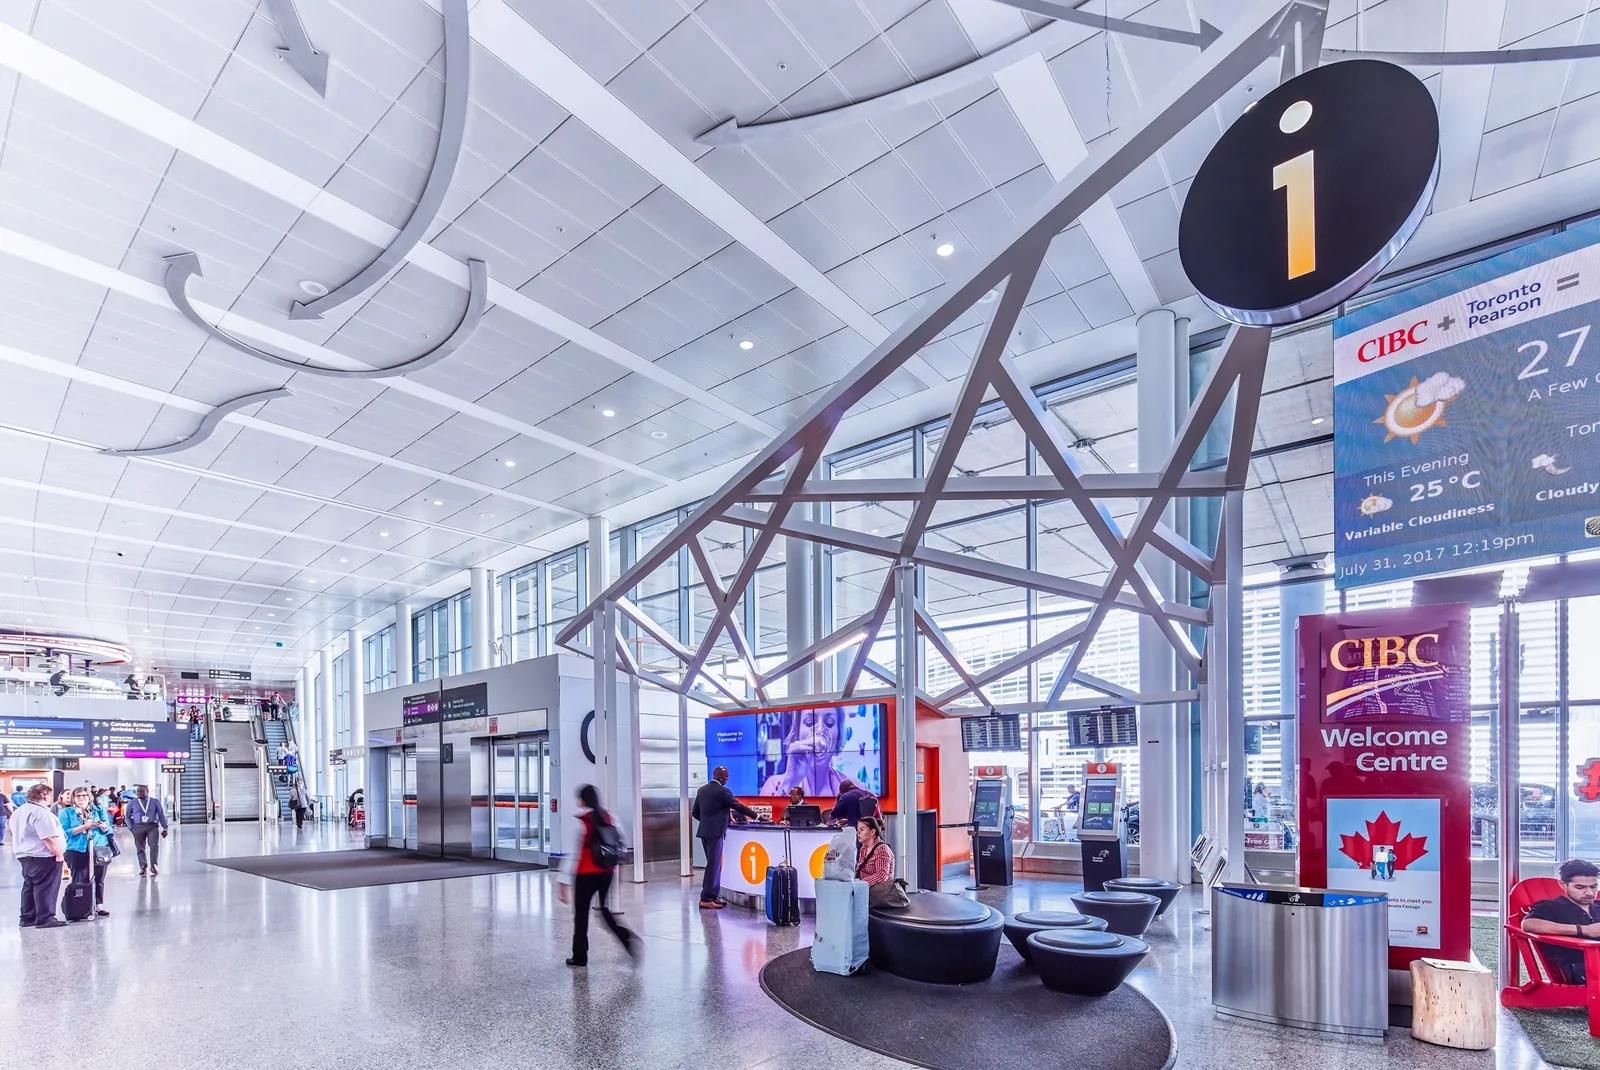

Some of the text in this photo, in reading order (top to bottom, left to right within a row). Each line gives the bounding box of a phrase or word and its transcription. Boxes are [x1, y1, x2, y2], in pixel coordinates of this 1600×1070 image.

[1466, 282, 1541, 314] Toronto
[1468, 297, 1541, 328] Pearson
[1357, 320, 1429, 363] CIBC
[1517, 325, 1593, 381] 27
[1527, 388, 1542, 402] A
[1548, 377, 1588, 397] Few
[1363, 453, 1469, 487] This Evening
[1535, 482, 1600, 501] Cloudy
[1344, 502, 1496, 541] Variable Cloudiness
[1339, 532, 1535, 579] July 31, 2017 12:19pm
[1329, 633, 1439, 672] CIBC
[1320, 726, 1449, 748] Welcome
[1356, 752, 1449, 772] Centre
